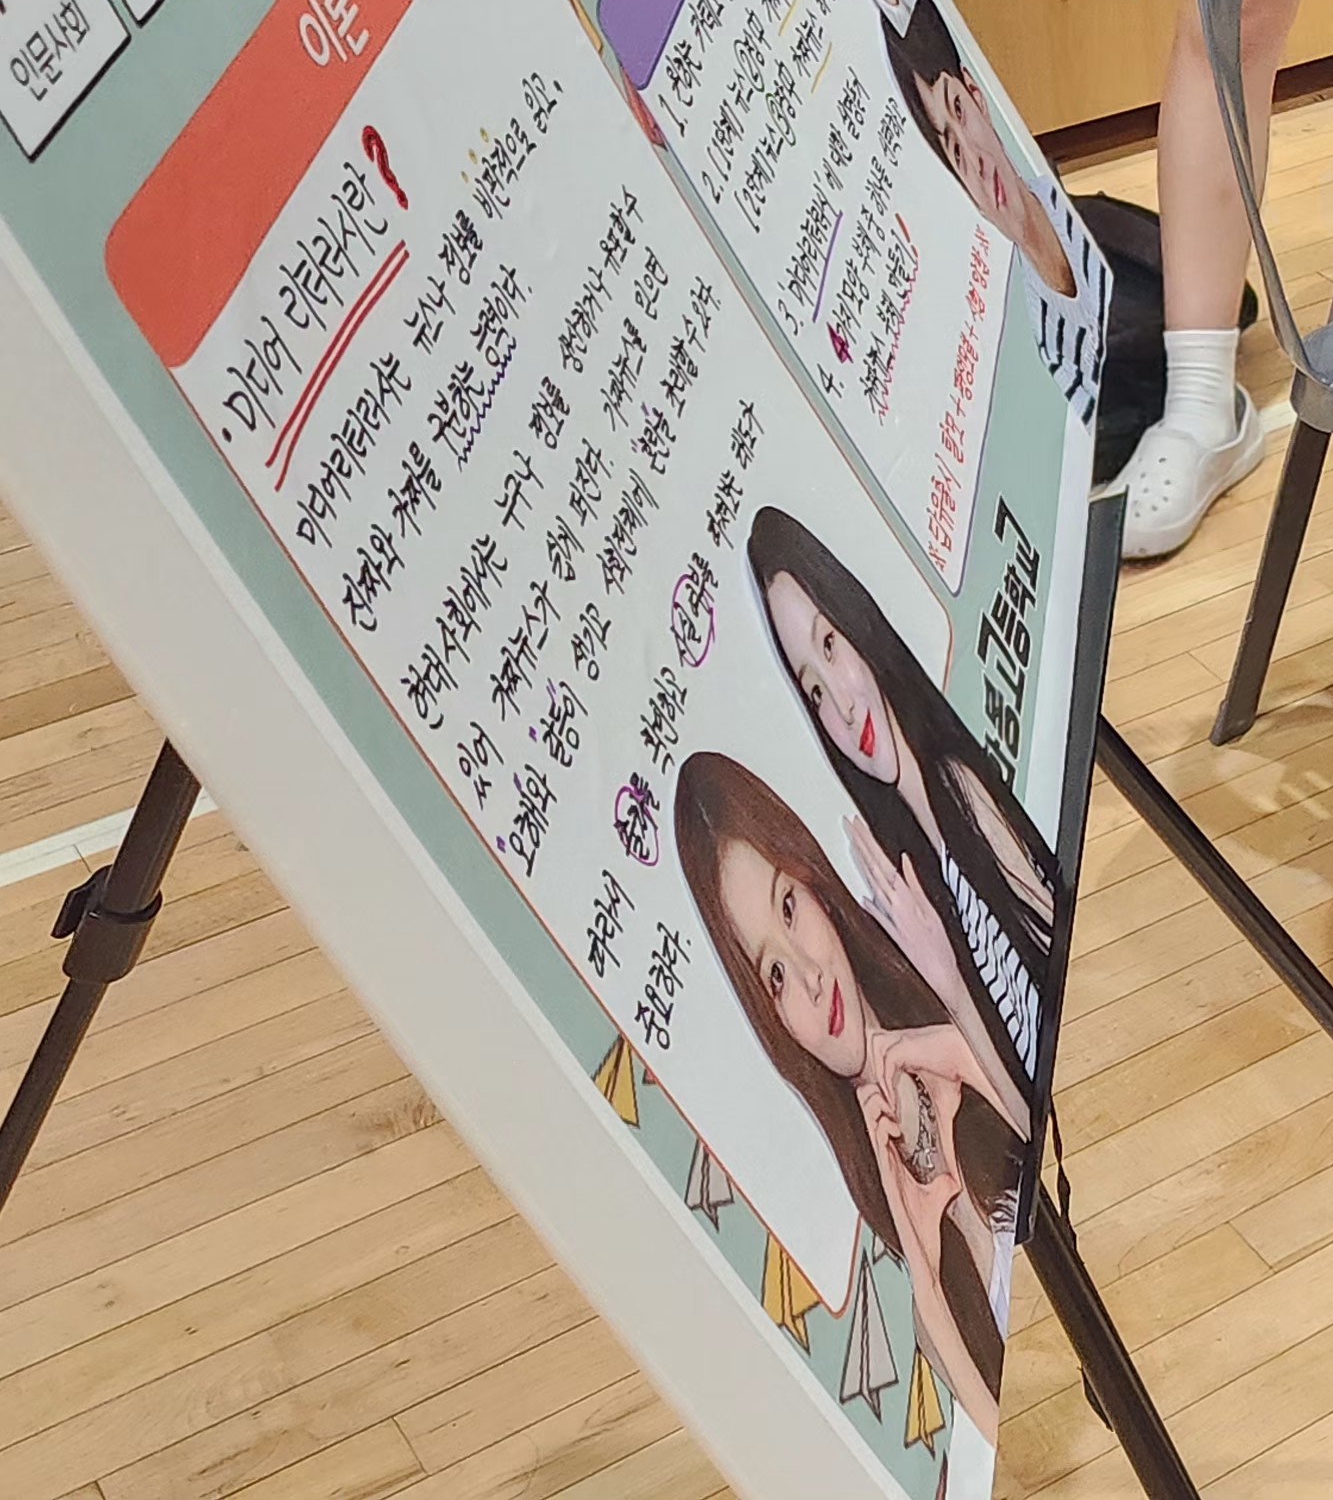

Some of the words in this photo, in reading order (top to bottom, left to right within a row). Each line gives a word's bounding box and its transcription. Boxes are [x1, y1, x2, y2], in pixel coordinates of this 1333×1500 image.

[664, 39, 703, 107] 원하는
[725, 68, 754, 113] 뉴스
[757, 122, 784, 163] 뉴스
[789, 8, 823, 77] 가짜뉴스
[827, 122, 853, 167] 대한
[877, 96, 907, 167] 선택하고
[864, 155, 893, 216] 하나를
[403, 275, 456, 354] 뉴스나
[438, 209, 483, 285] 정보를
[473, 117, 536, 219] 비판적으로
[681, 313, 706, 353] 수
[689, 275, 720, 338] 있다.
[223, 315, 302, 430] 미디어
[493, 449, 544, 530] 누구나
[528, 375, 570, 449] 정보를
[558, 266, 612, 373] 생산하거나
[659, 335, 698, 418] 초래할
[341, 523, 404, 631] 진짜와
[387, 441, 442, 537] 가짜를
[427, 360, 485, 455] 구분하는
[470, 264, 532, 367] 능력이다.
[456, 721, 504, 810] 있어
[489, 580, 560, 719] 가짜뉴스가
[545, 514, 585, 582] 쉽게
[568, 437, 611, 526] 퍼진다.
[600, 317, 647, 430] 가짜뉴스를
[570, 602, 611, 681] 생기고
[586, 869, 634, 977] 따라서
[639, 666, 687, 773] 확인하고
[730, 399, 764, 470] 태도가
[634, 921, 690, 1049] 중요하다.
